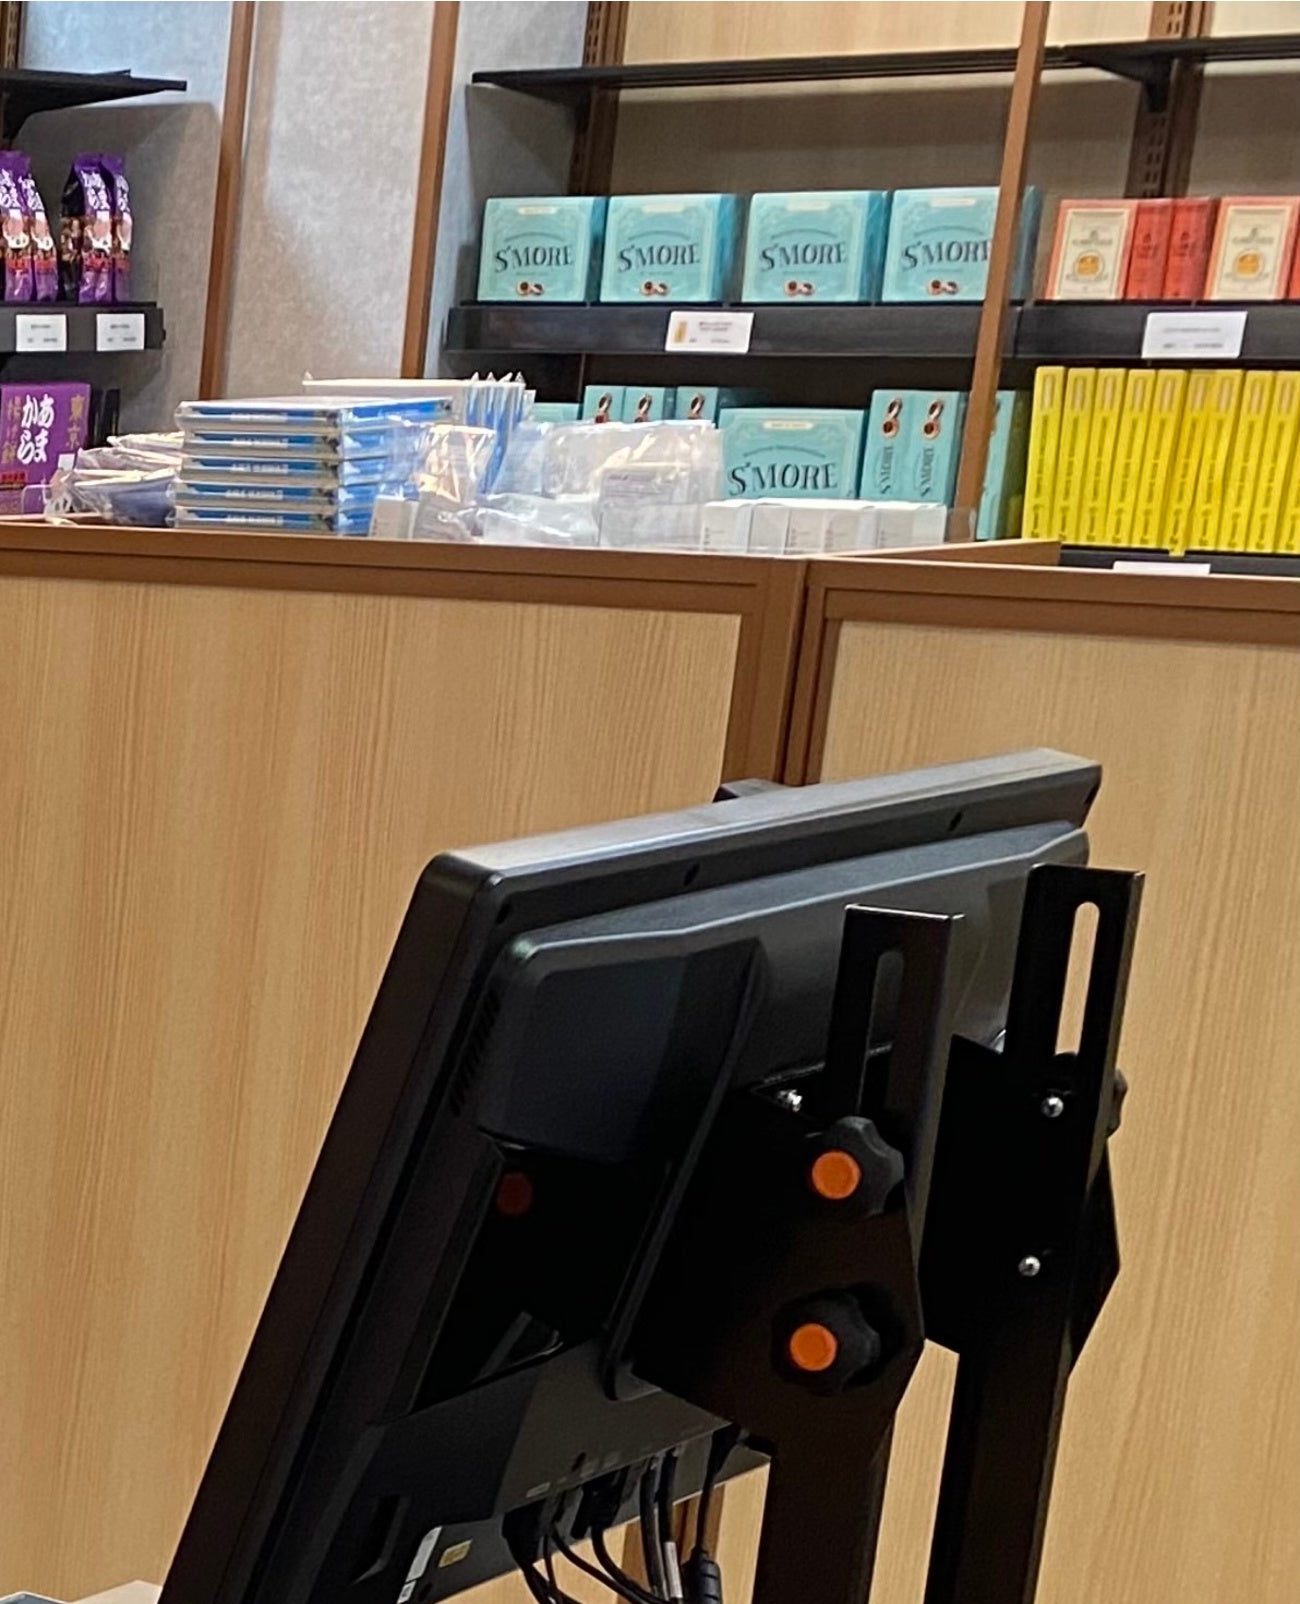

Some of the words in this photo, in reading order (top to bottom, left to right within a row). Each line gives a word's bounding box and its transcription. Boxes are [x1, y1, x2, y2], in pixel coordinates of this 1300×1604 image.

[494, 245, 574, 273] S'MORE
[617, 244, 701, 273] S'MORE
[760, 242, 847, 271] S'MORE
[729, 461, 838, 497] S'MORE
